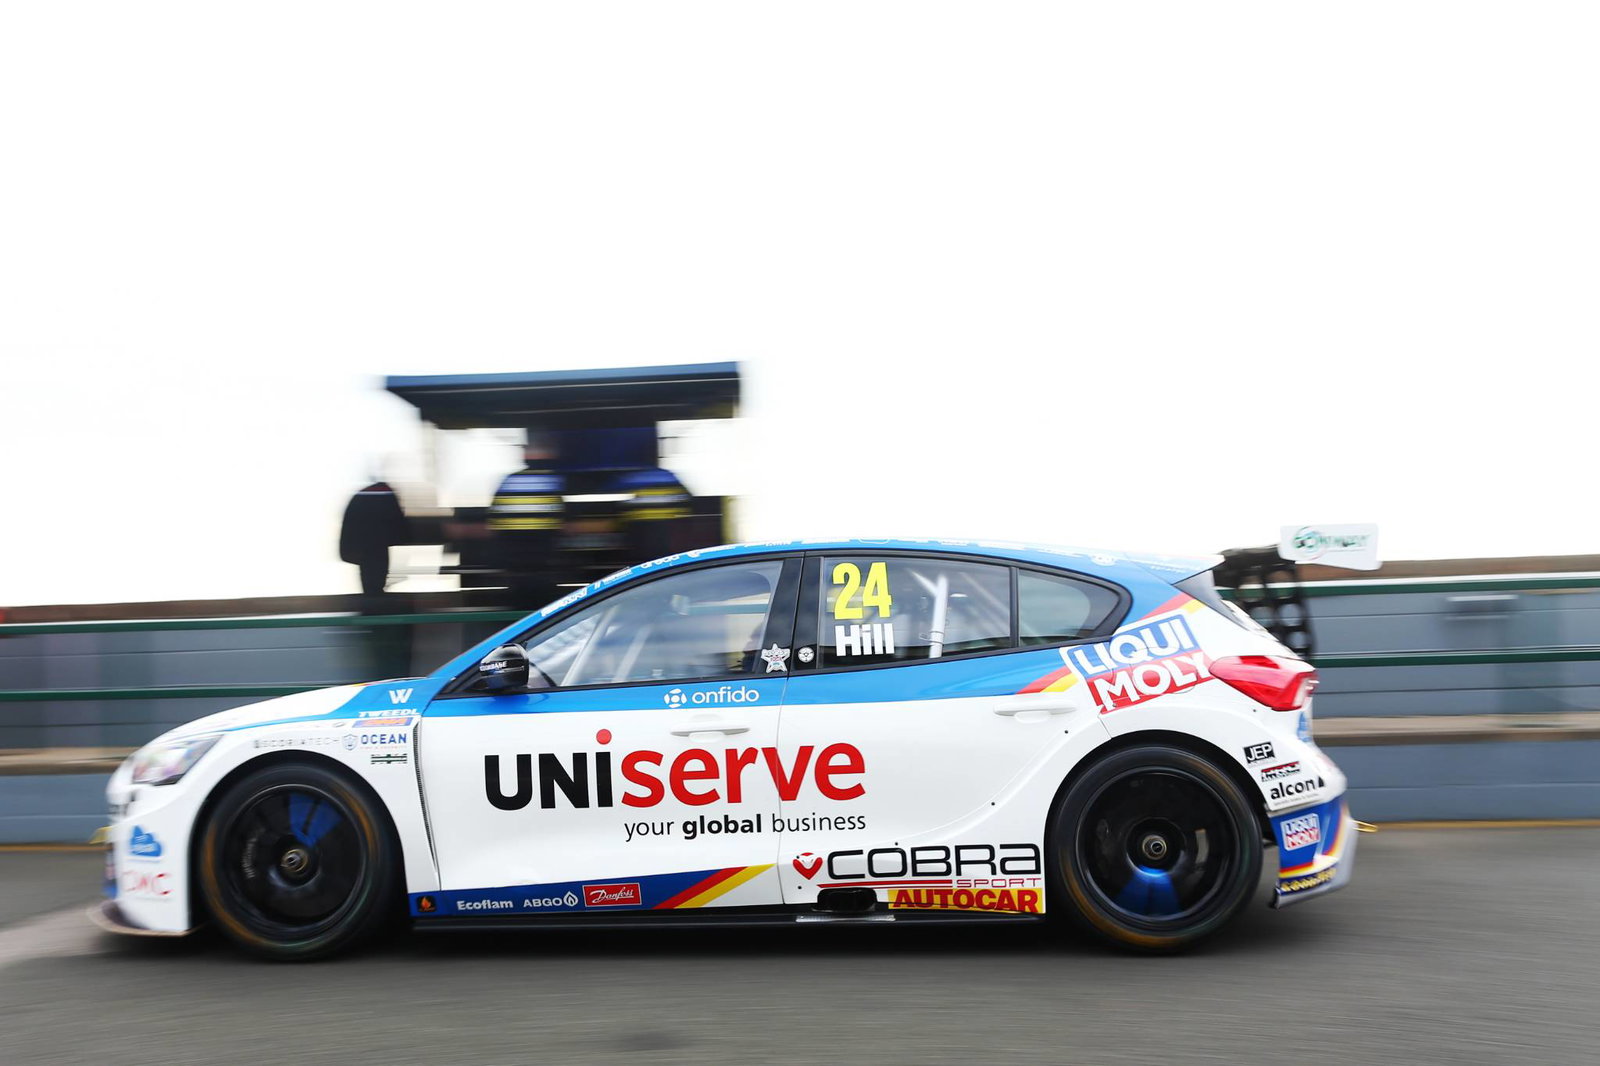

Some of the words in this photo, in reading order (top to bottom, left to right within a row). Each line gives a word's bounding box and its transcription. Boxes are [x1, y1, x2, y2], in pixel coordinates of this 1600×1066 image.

[832, 561, 892, 620] 24
[834, 623, 895, 657] Hill
[1073, 618, 1195, 675] LIQUI
[1093, 651, 1212, 712] MOLY
[691, 685, 760, 704] onfido
[360, 733, 407, 745] OCEAN
[1246, 743, 1273, 762] JEP
[1270, 778, 1316, 800] alcon
[624, 819, 675, 842] your
[682, 813, 763, 840] global
[771, 812, 867, 834] business
[956, 877, 1042, 888] SPORT
[456, 899, 514, 911] Ecoflam
[523, 897, 563, 909] ABGO
[589, 885, 635, 904] Danfoss
[892, 888, 1039, 913] AUTOCAR
